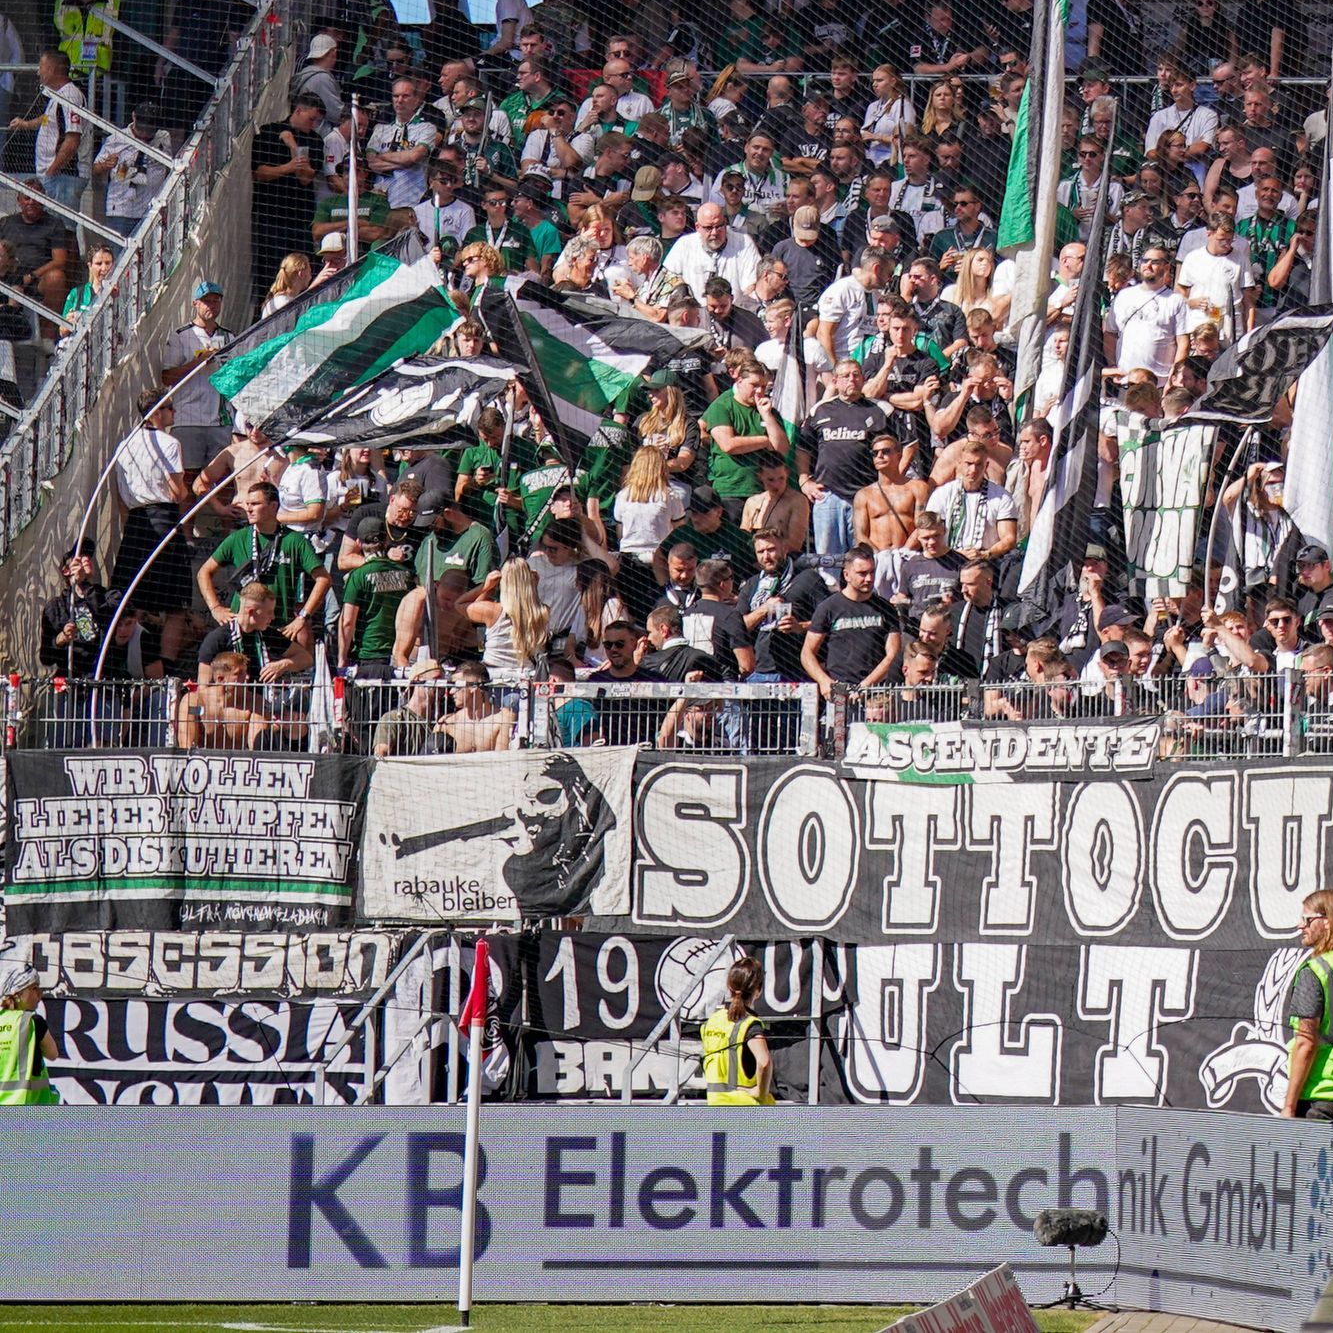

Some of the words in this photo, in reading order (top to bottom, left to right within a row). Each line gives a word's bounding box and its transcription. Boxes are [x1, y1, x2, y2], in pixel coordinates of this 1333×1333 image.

[821, 426, 866, 442] Belinea
[847, 721, 1161, 775] ASCENDENTE
[66, 756, 150, 798] WIR
[150, 755, 315, 799] WOLLEN
[15, 796, 168, 842] LIEBER
[168, 790, 357, 842] KÄMPFEN
[13, 837, 98, 883] ALS
[100, 836, 353, 883] DISKUTIEREN
[393, 876, 481, 896] rabauke
[544, 935, 641, 1032] 19
[287, 1130, 494, 1270] KB
[543, 1129, 1166, 1236] Elektrotechnik
[1183, 1140, 1299, 1254] GmbH
